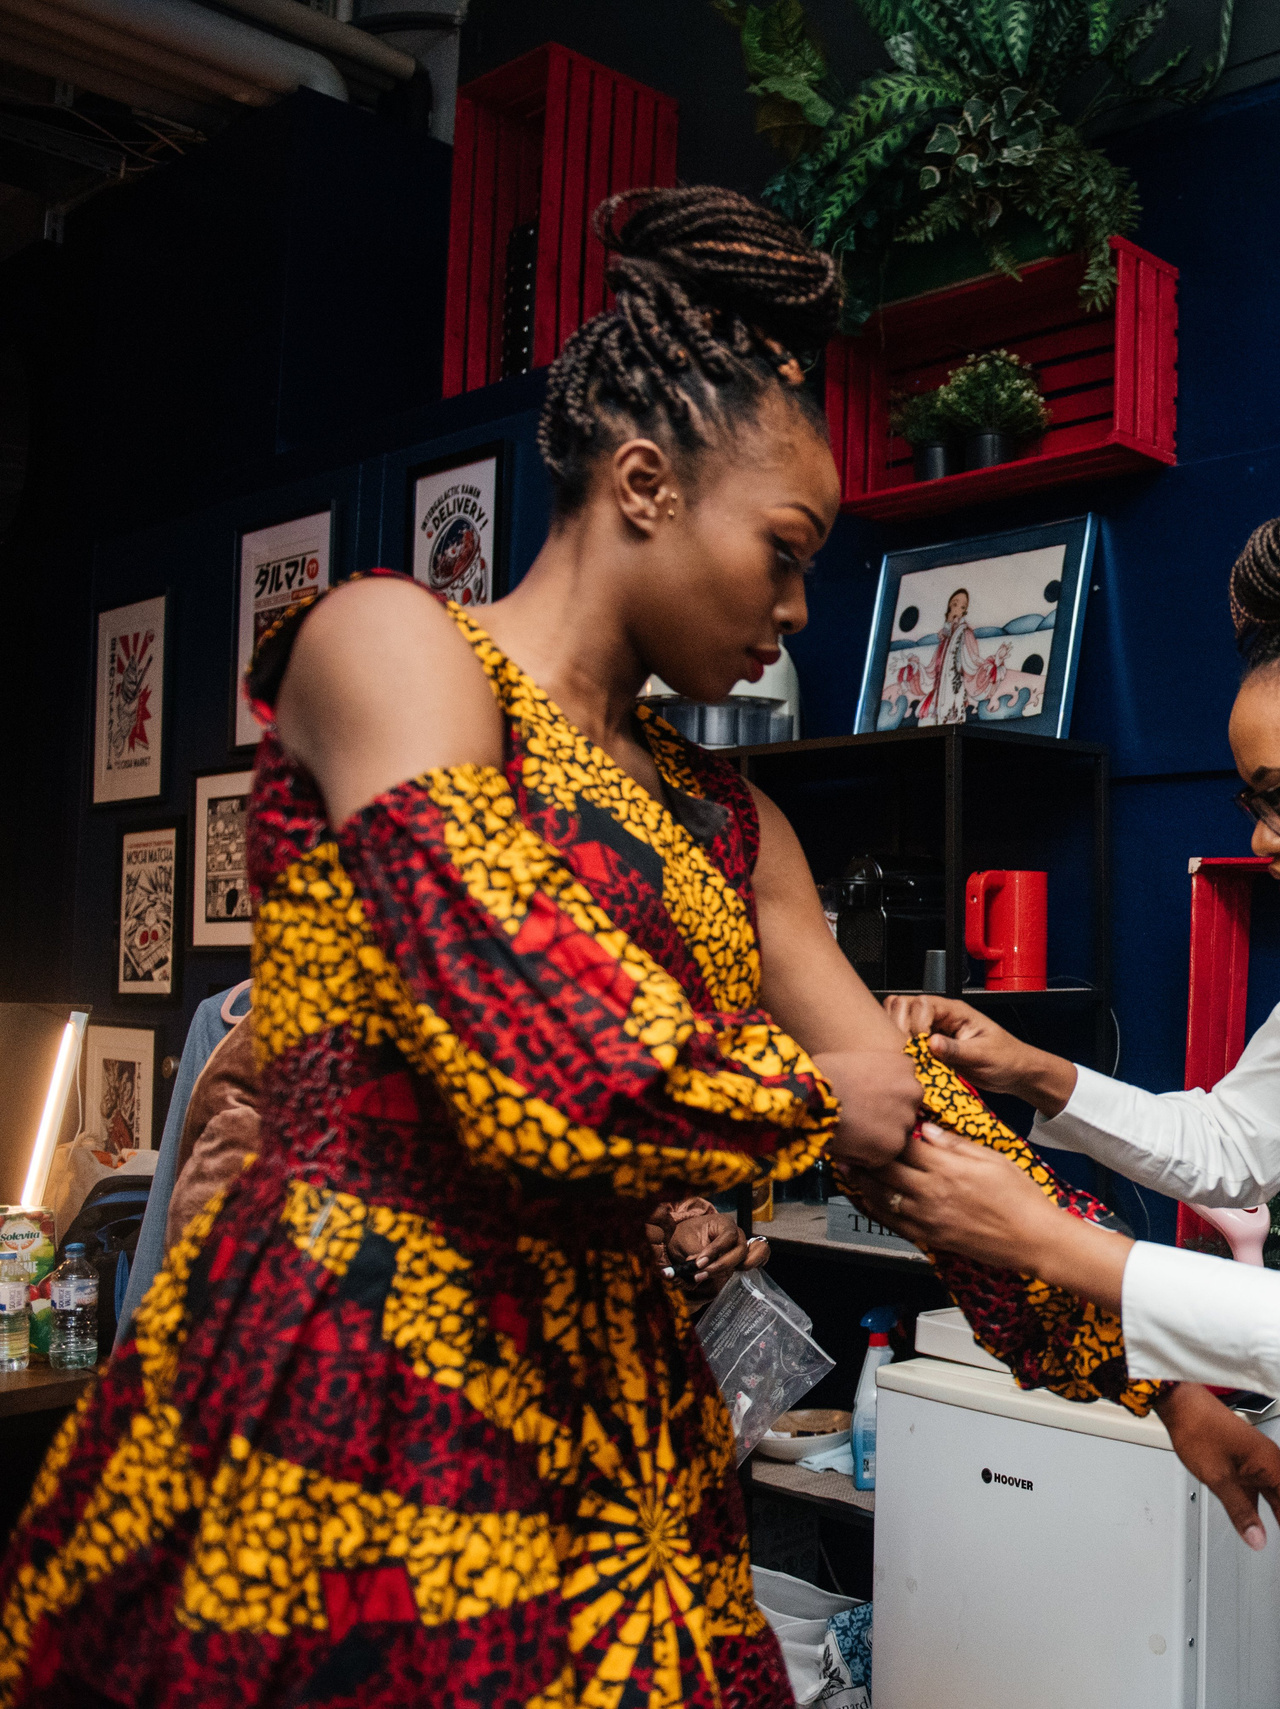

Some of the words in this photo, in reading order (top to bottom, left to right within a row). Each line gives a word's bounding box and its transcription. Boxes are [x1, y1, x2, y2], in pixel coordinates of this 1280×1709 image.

[461, 484, 482, 500] RAMEN
[148, 847, 173, 863] MATCHA
[0, 1230, 40, 1241] Solevita
[994, 1472, 1034, 1491] HOOVER
